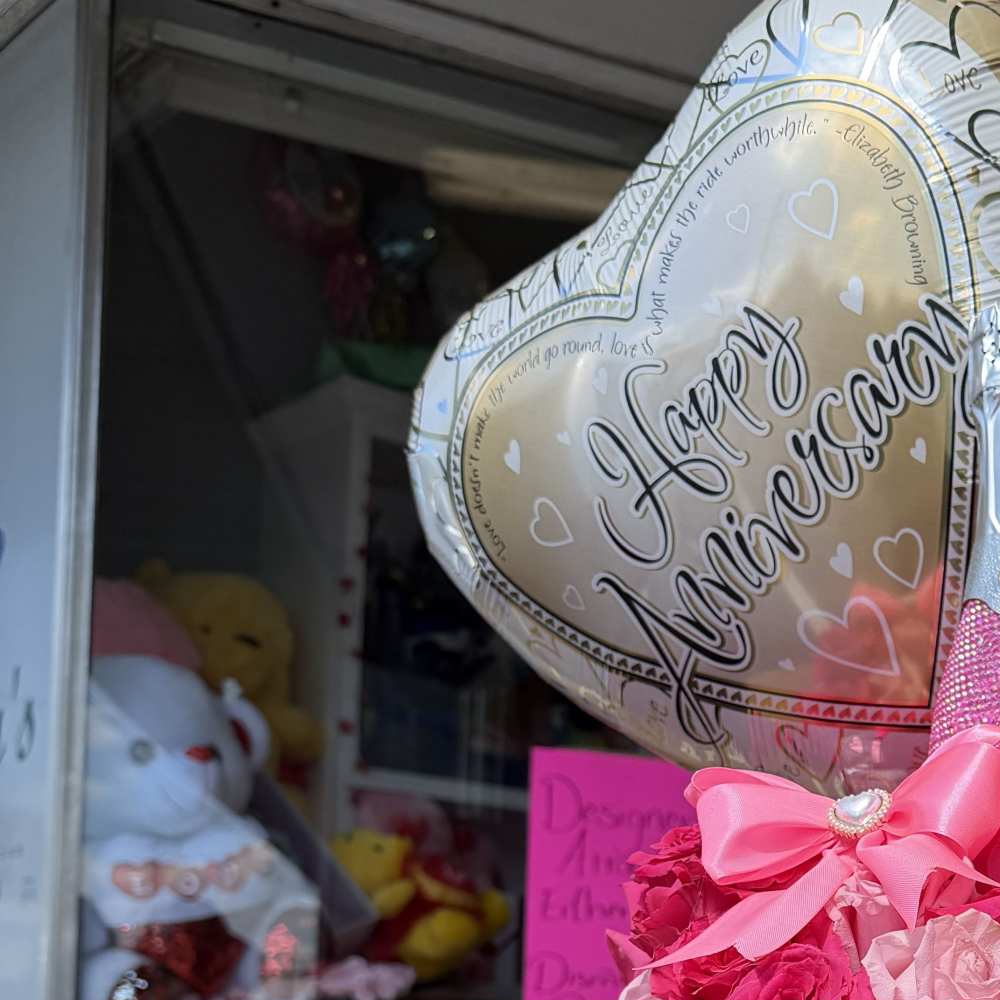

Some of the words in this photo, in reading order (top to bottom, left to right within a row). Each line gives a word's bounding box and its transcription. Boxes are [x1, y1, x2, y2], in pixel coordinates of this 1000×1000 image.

[697, 166, 724, 199] ride
[676, 199, 698, 229] the
[890, 193, 929, 287] Browning
[659, 231, 683, 285] makes
[646, 291, 670, 336] what
[543, 344, 559, 369] go
[610, 332, 637, 360] love
[641, 334, 655, 357] is
[507, 351, 541, 386] world
[476, 408, 492, 450] make
[586, 305, 799, 565] Happy
